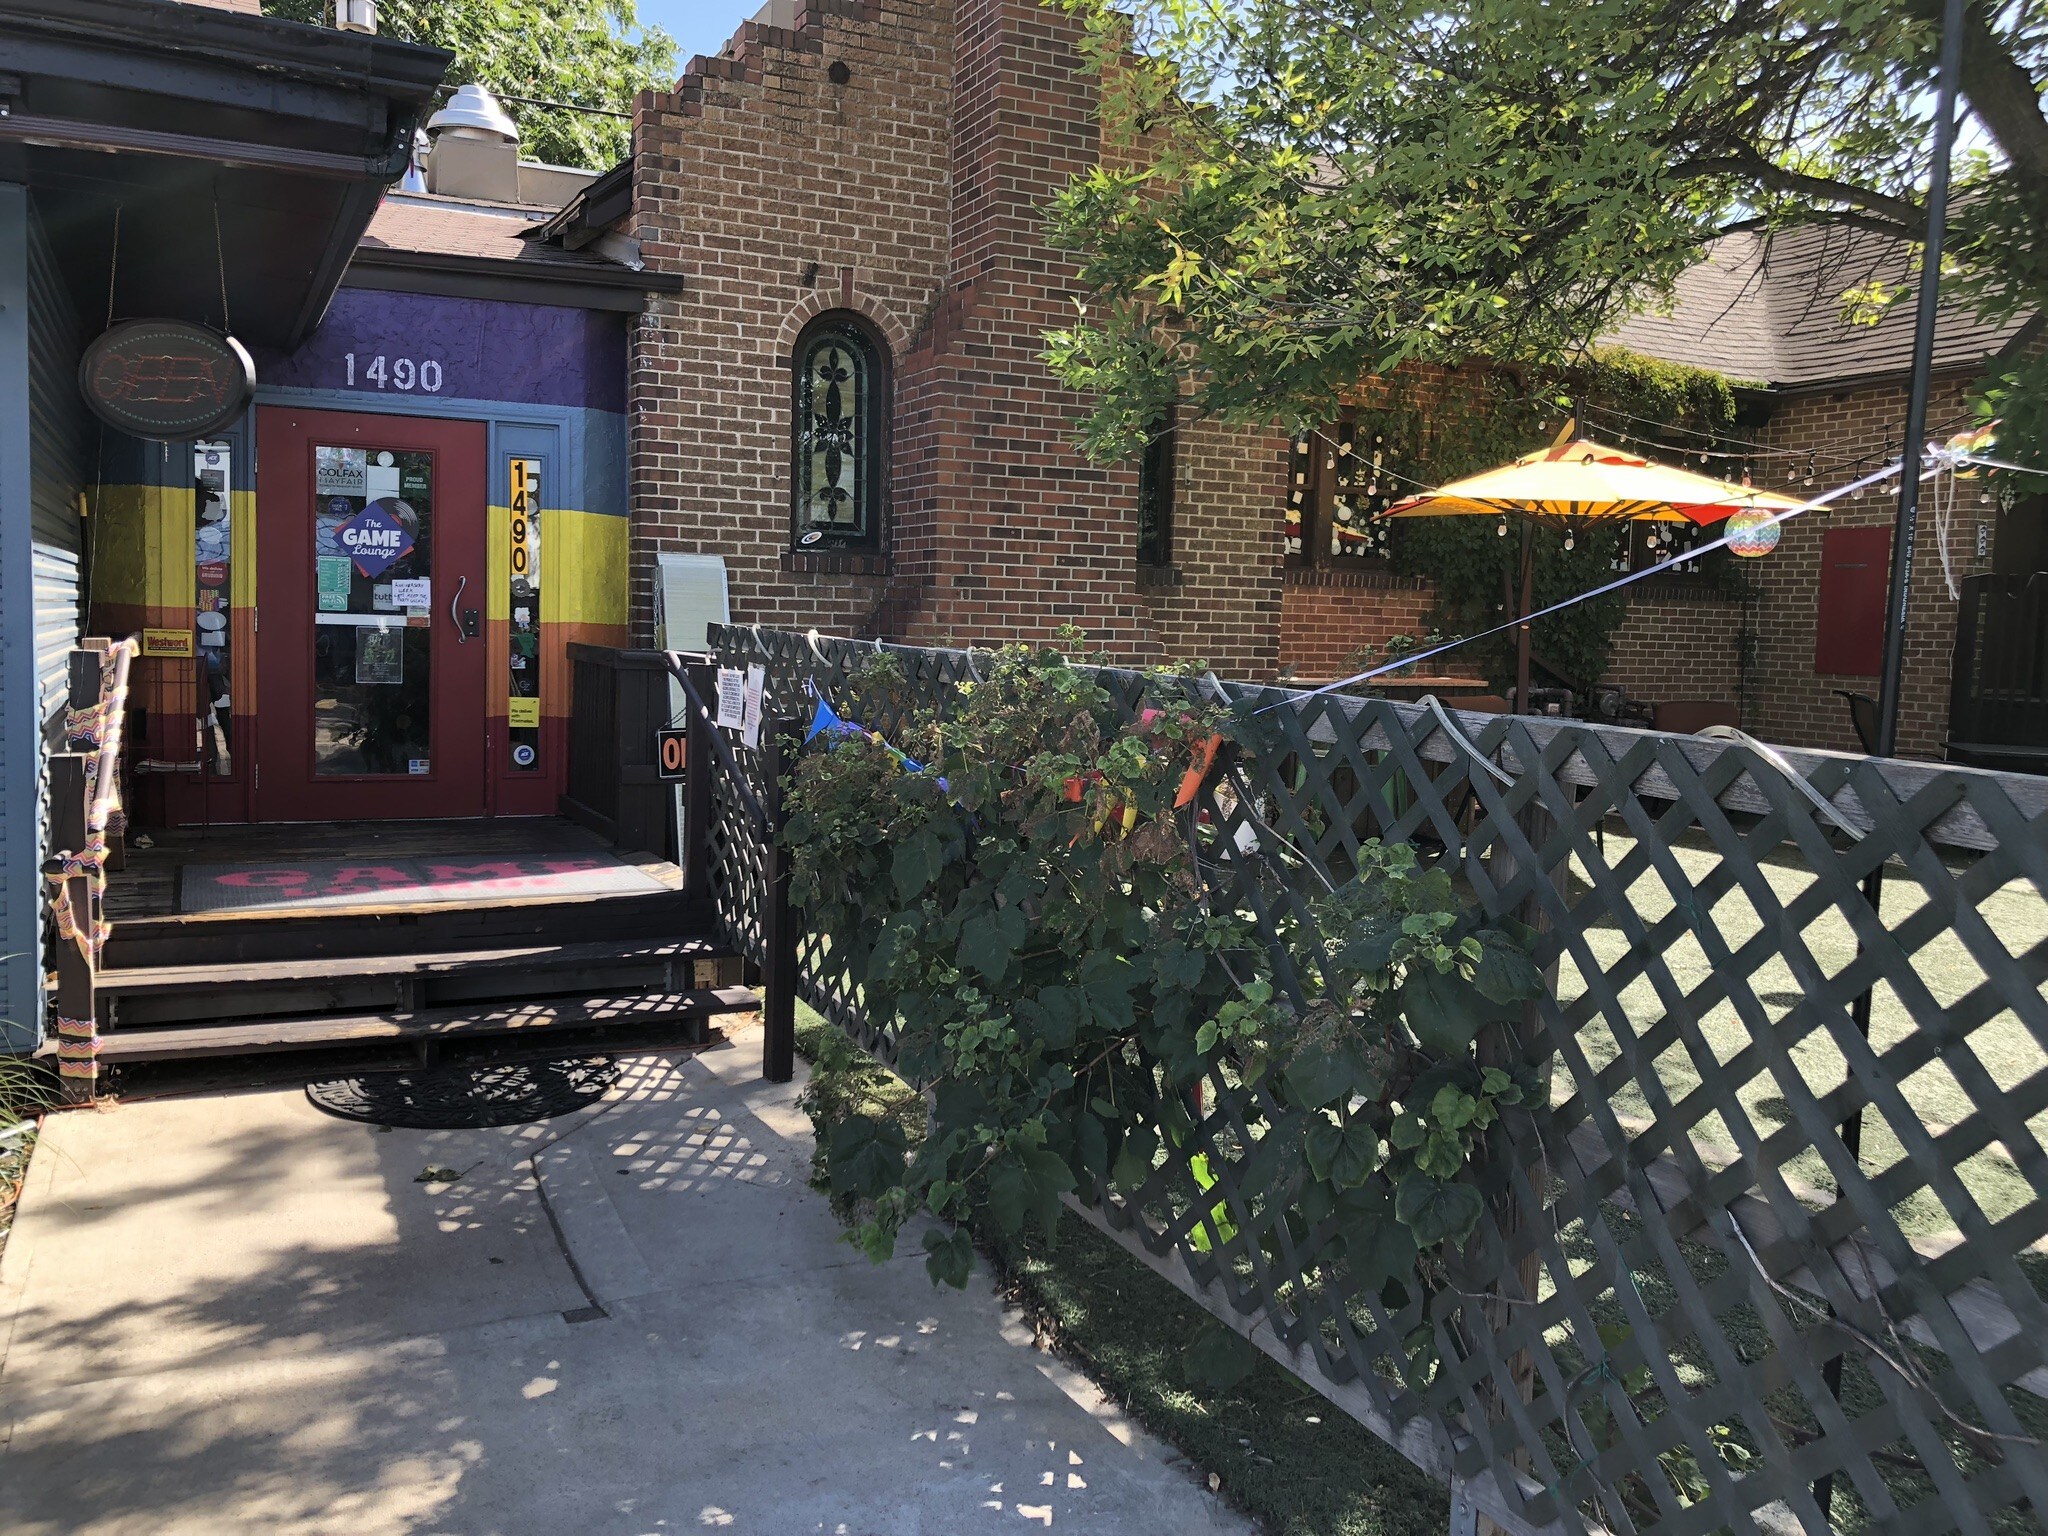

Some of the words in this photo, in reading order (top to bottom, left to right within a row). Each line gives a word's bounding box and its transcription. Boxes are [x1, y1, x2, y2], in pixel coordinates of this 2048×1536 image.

[344, 353, 442, 392] 1490
[318, 468, 363, 479] COLFAX
[364, 518, 383, 529] The
[513, 462, 526, 572] 1490
[342, 528, 402, 548] GAME
[351, 544, 396, 560] Lounge
[147, 636, 188, 648] Westword
[214, 858, 614, 886] GAME
